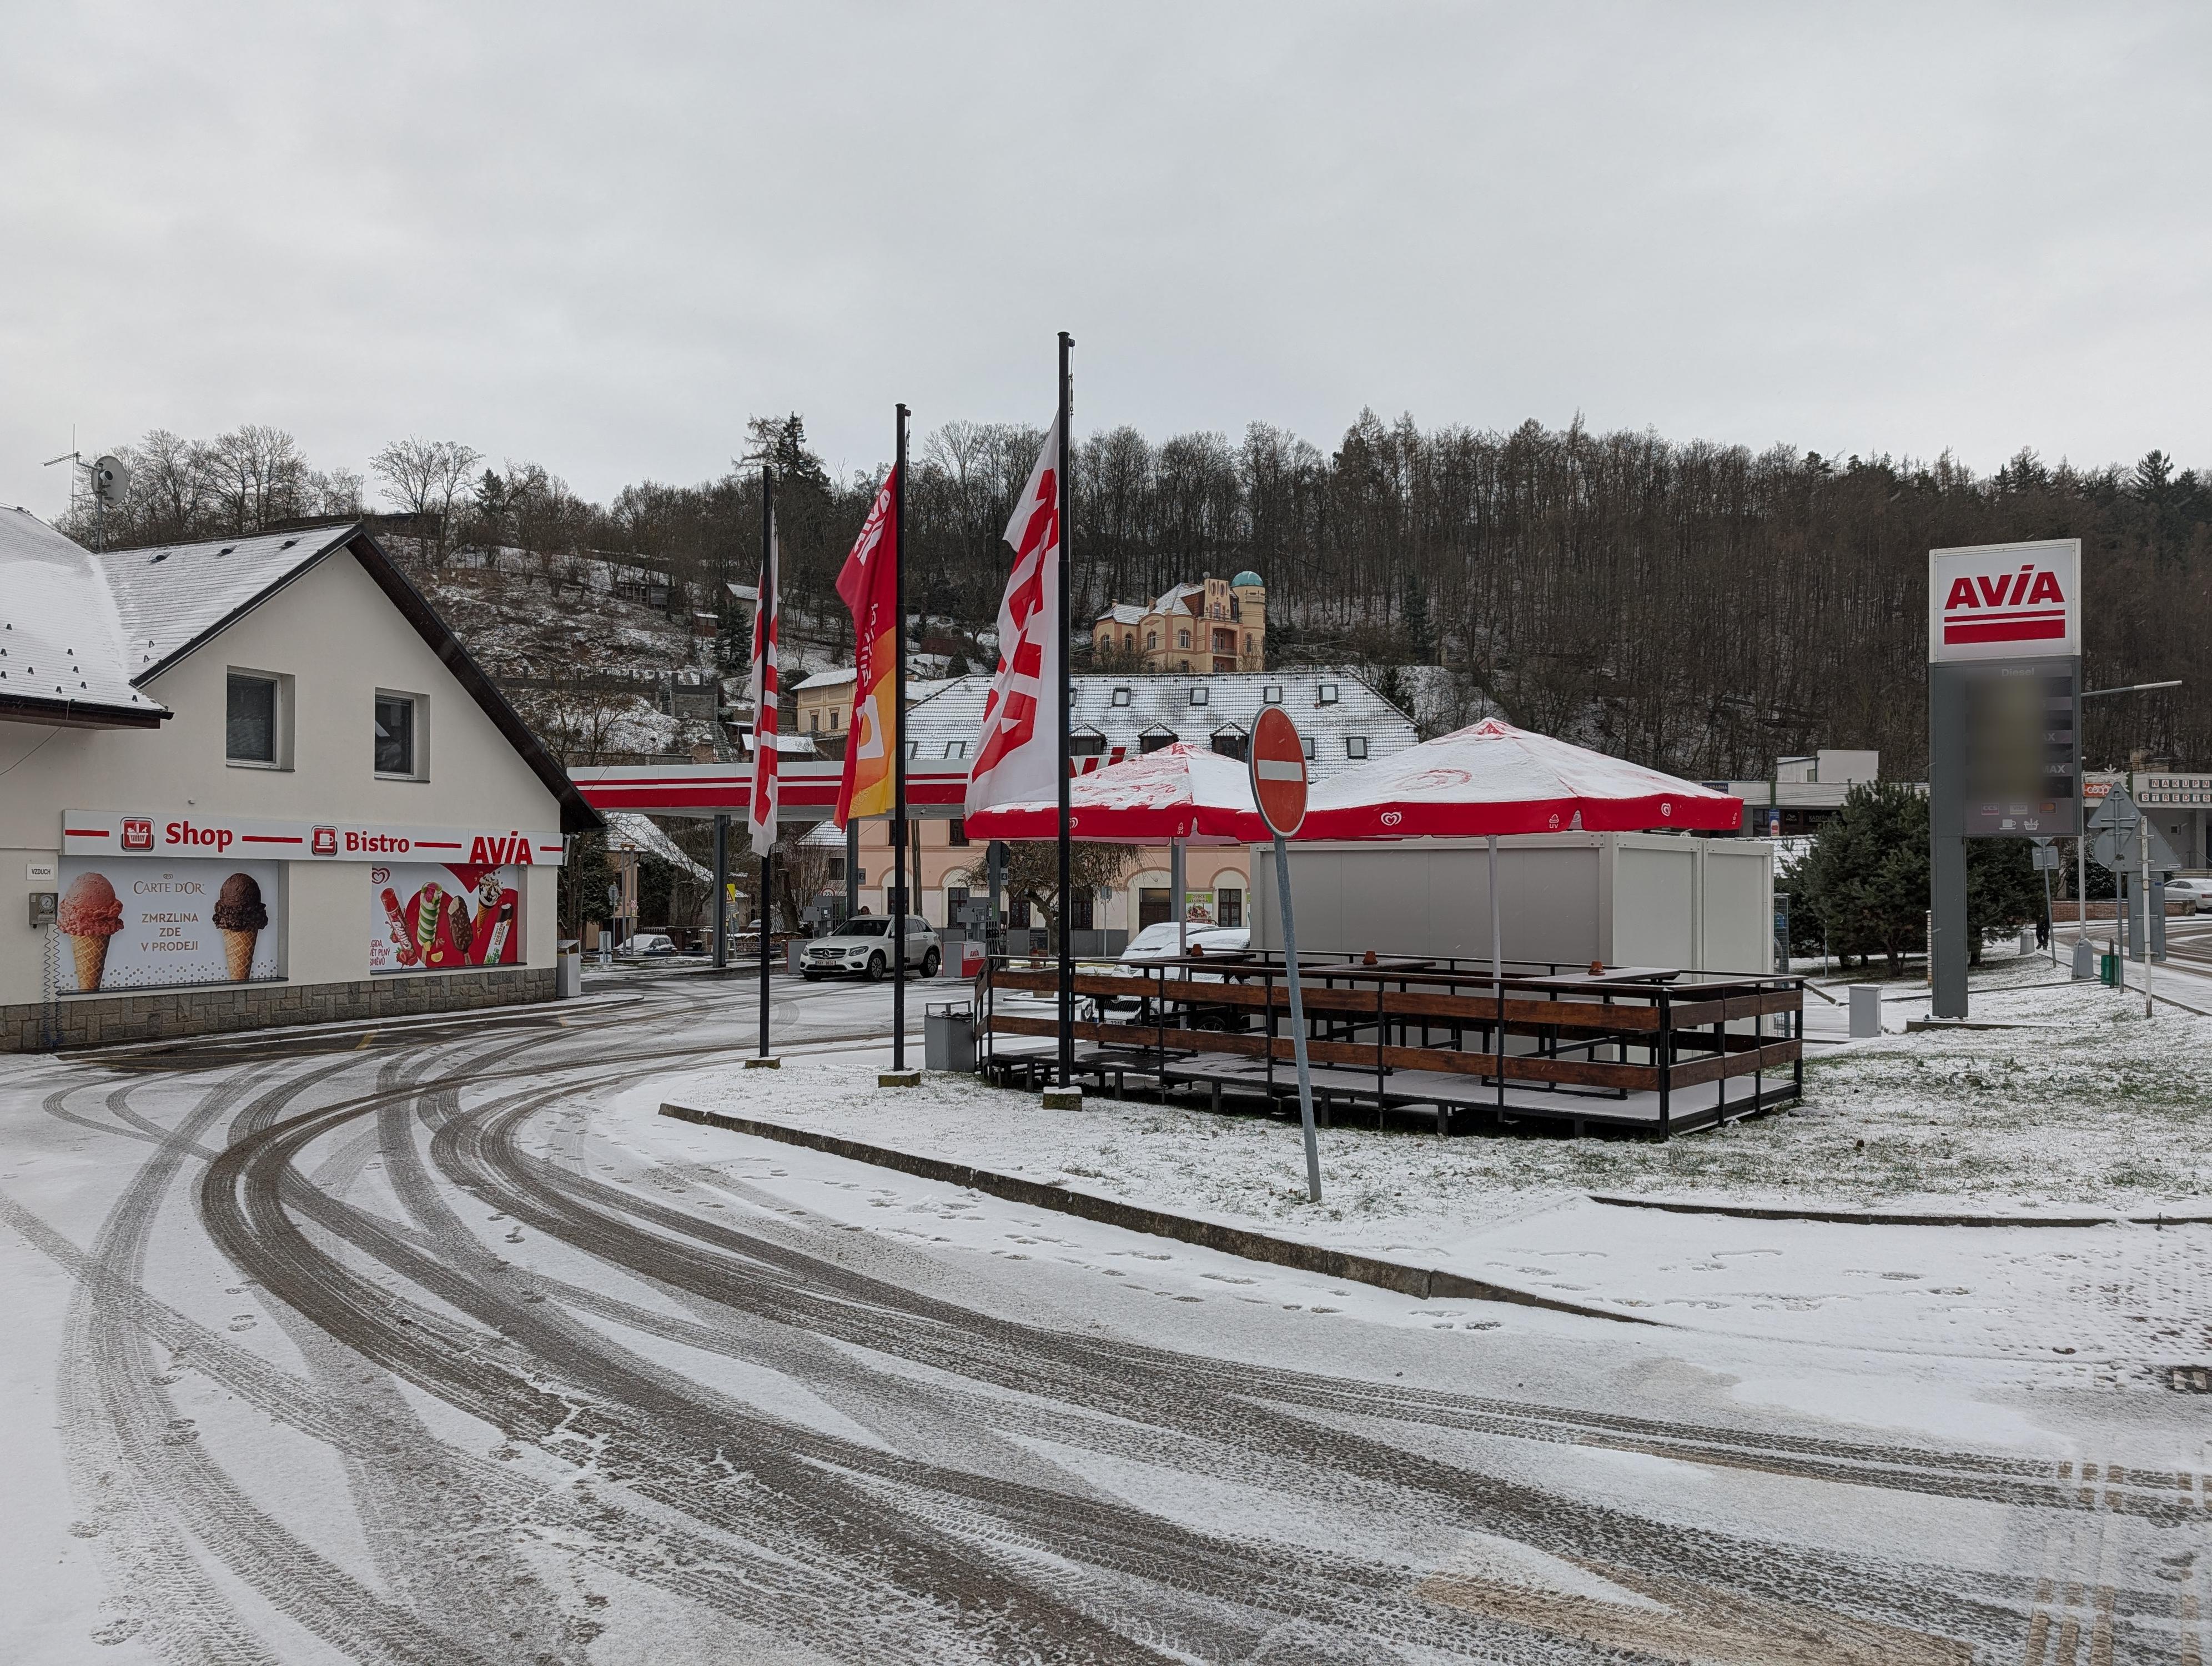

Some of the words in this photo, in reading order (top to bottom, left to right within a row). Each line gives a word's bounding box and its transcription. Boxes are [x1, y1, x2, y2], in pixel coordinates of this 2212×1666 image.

[2001, 668, 2034, 676] Diesel
[165, 821, 233, 853] Shop
[344, 831, 410, 853] Bistro
[133, 881, 170, 895] CARTE
[141, 913, 199, 923] ZMRZLINA
[159, 927, 181, 937] ZDE
[141, 944, 149, 952] V
[152, 941, 198, 952] PRODEJI
[370, 940, 383, 948] GIDA,
